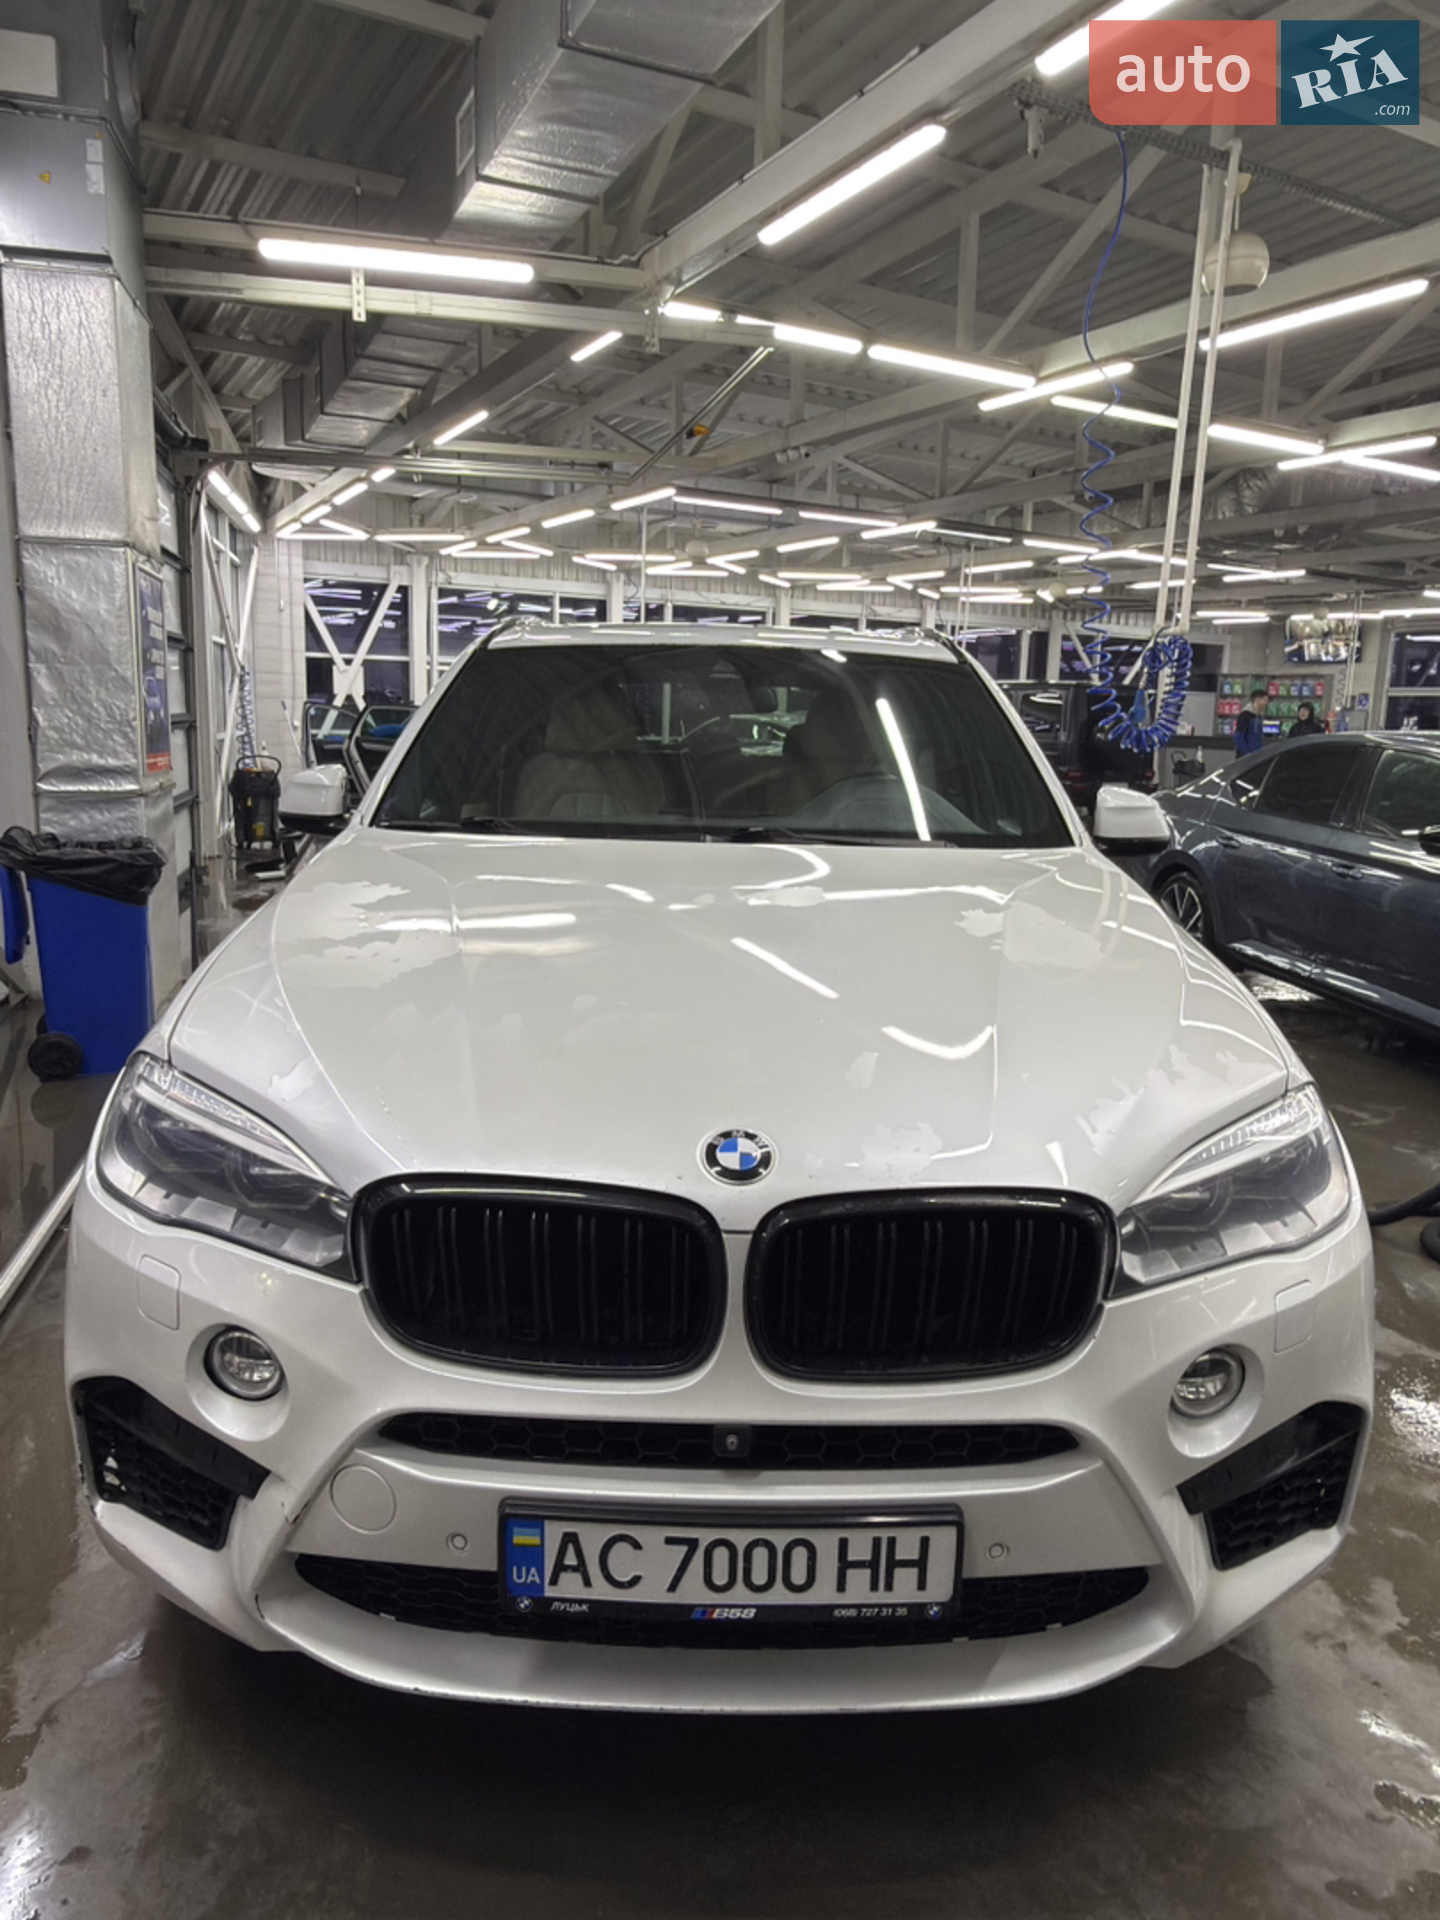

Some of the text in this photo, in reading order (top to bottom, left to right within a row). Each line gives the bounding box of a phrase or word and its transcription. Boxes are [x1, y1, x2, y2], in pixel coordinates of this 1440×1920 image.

[548, 1531, 930, 1594] AC 7000 HH
[512, 1565, 541, 1585] UA
[860, 1607, 879, 1617] 727
[880, 1607, 893, 1617] 31
